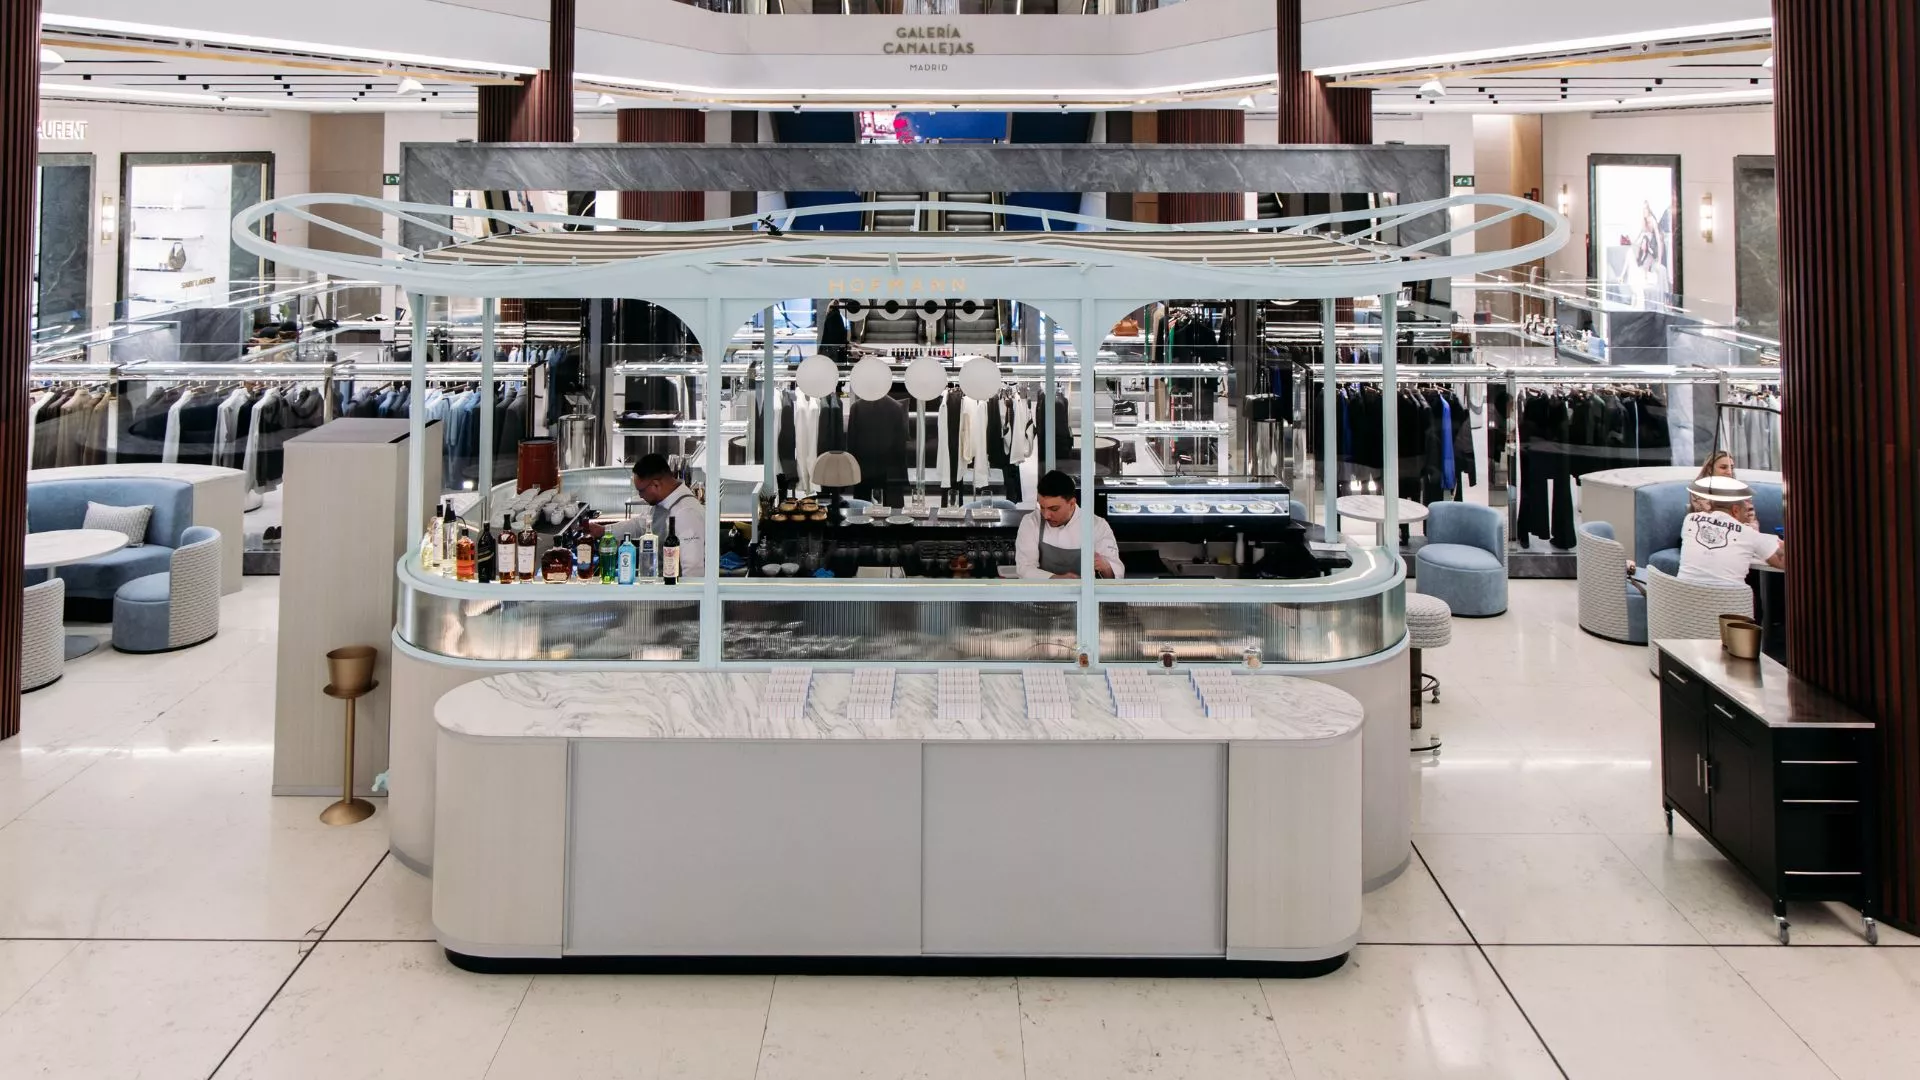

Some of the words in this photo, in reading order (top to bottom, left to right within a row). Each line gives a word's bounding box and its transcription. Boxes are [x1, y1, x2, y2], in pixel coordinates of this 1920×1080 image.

[896, 24, 961, 39] GALERÍA
[883, 42, 975, 56] CANALEJAS
[829, 277, 967, 294] HOFMANN
